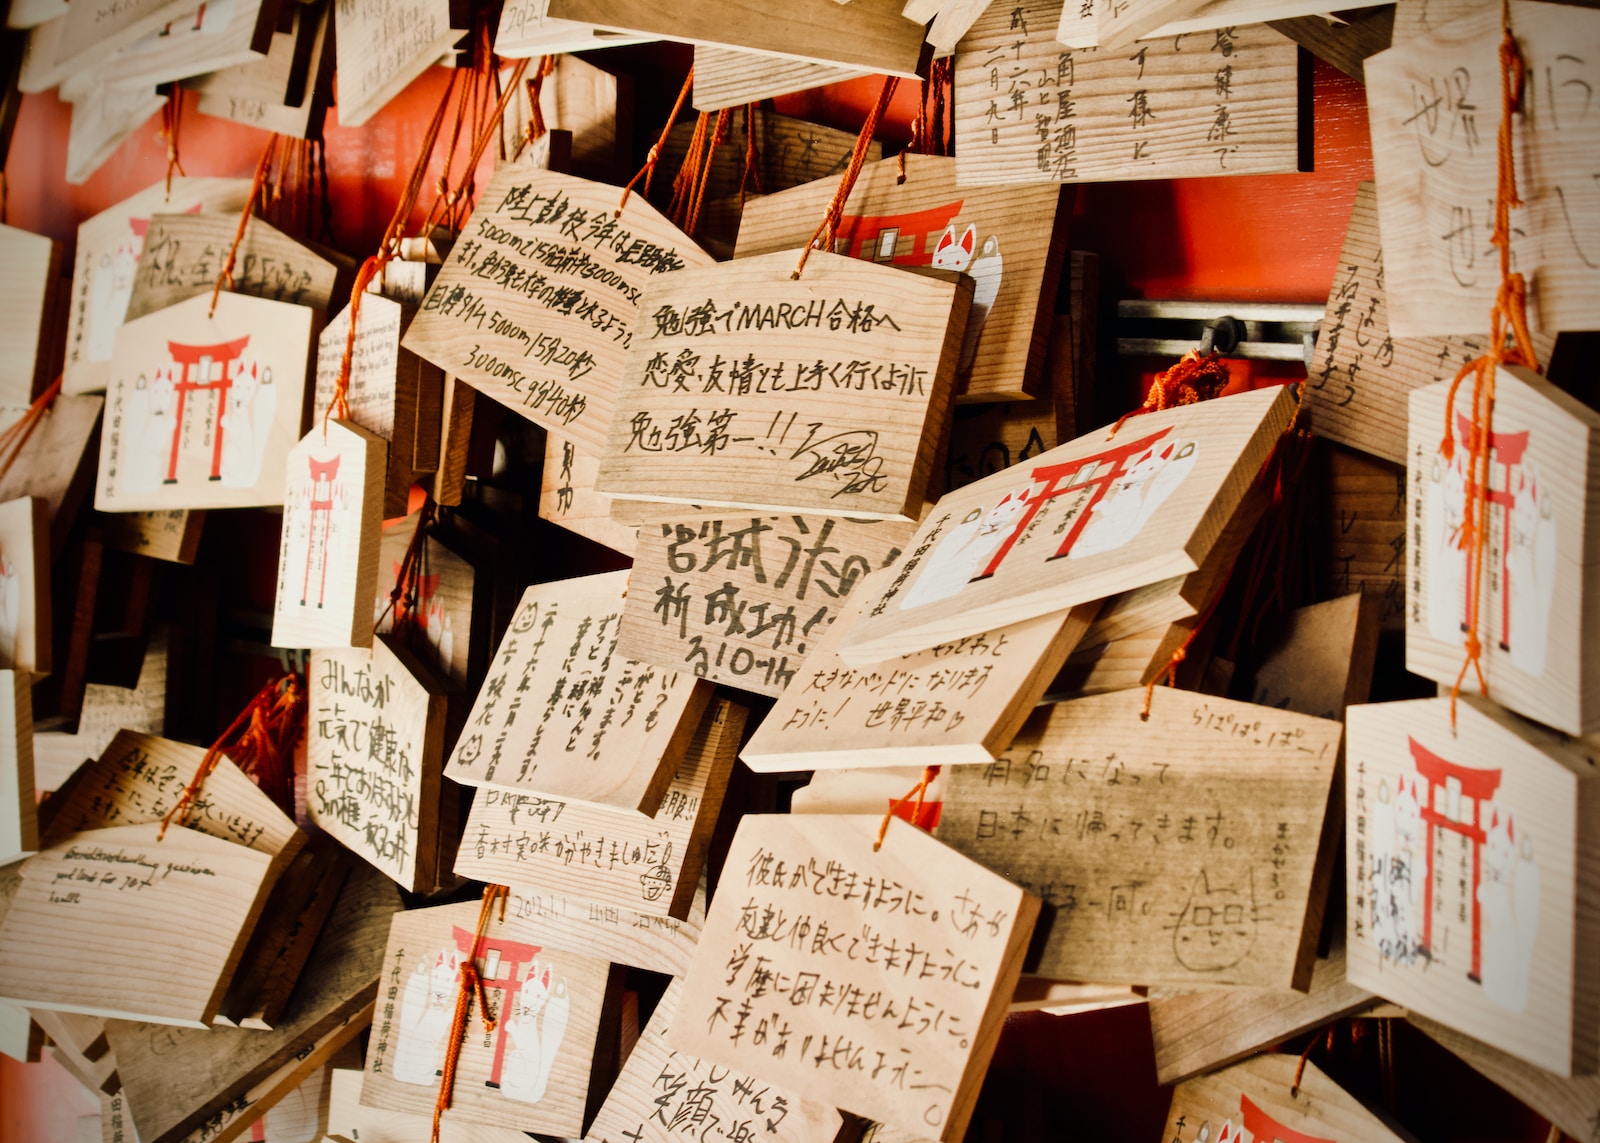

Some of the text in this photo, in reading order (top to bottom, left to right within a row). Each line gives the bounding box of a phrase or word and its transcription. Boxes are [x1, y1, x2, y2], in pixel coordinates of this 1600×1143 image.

[870, 513, 951, 617] 千代田稲荷神社
[621, 665, 655, 728] がとう
